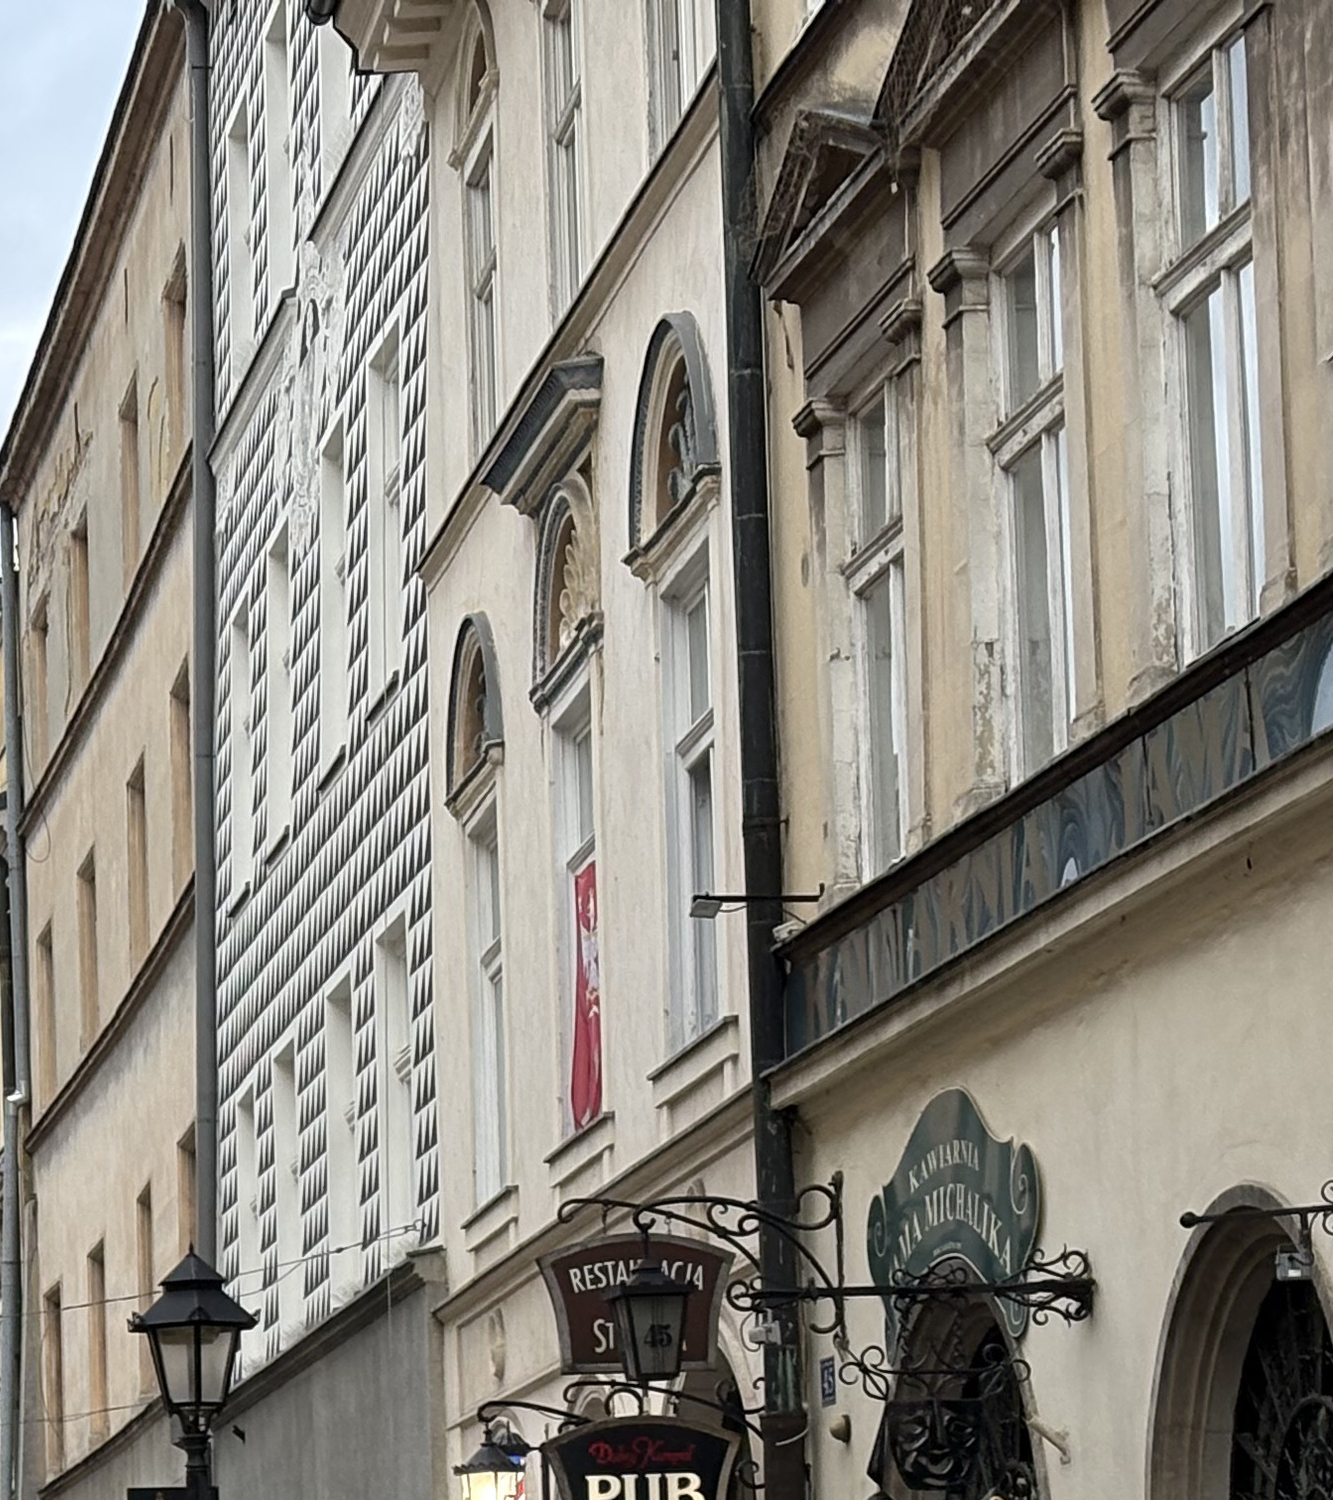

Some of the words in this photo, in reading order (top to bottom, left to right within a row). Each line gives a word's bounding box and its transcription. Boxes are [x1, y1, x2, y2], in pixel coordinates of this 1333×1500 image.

[908, 1139, 980, 1194] KAWIARNIA
[925, 1183, 1012, 1276] MICHALIKA
[644, 1323, 673, 1348] 45
